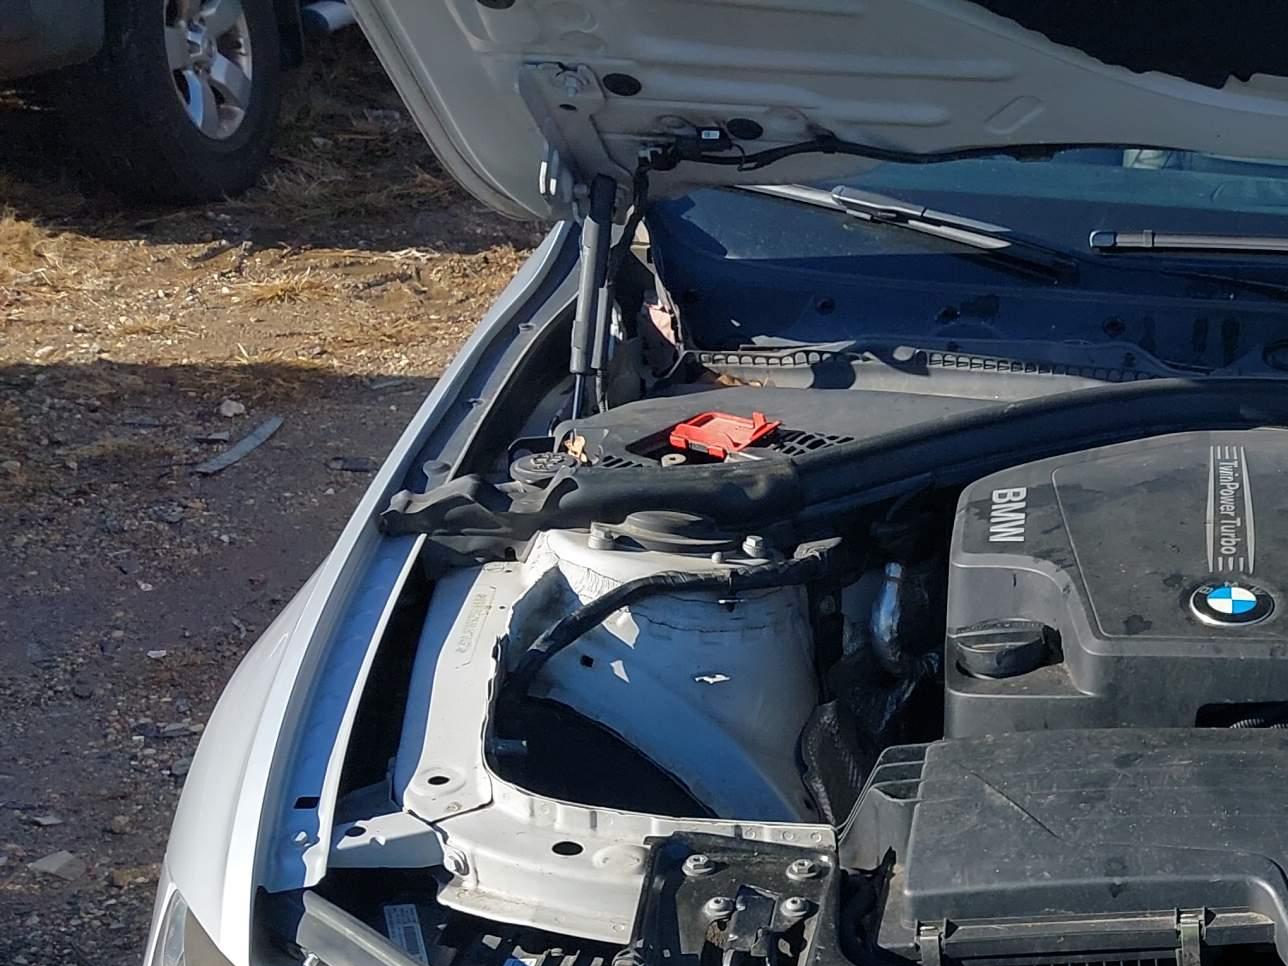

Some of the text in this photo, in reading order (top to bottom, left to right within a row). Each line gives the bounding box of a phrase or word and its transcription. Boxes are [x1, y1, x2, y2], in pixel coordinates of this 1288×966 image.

[989, 487, 1026, 541] BMW
[1219, 461, 1241, 554] TwinPower Turbo
